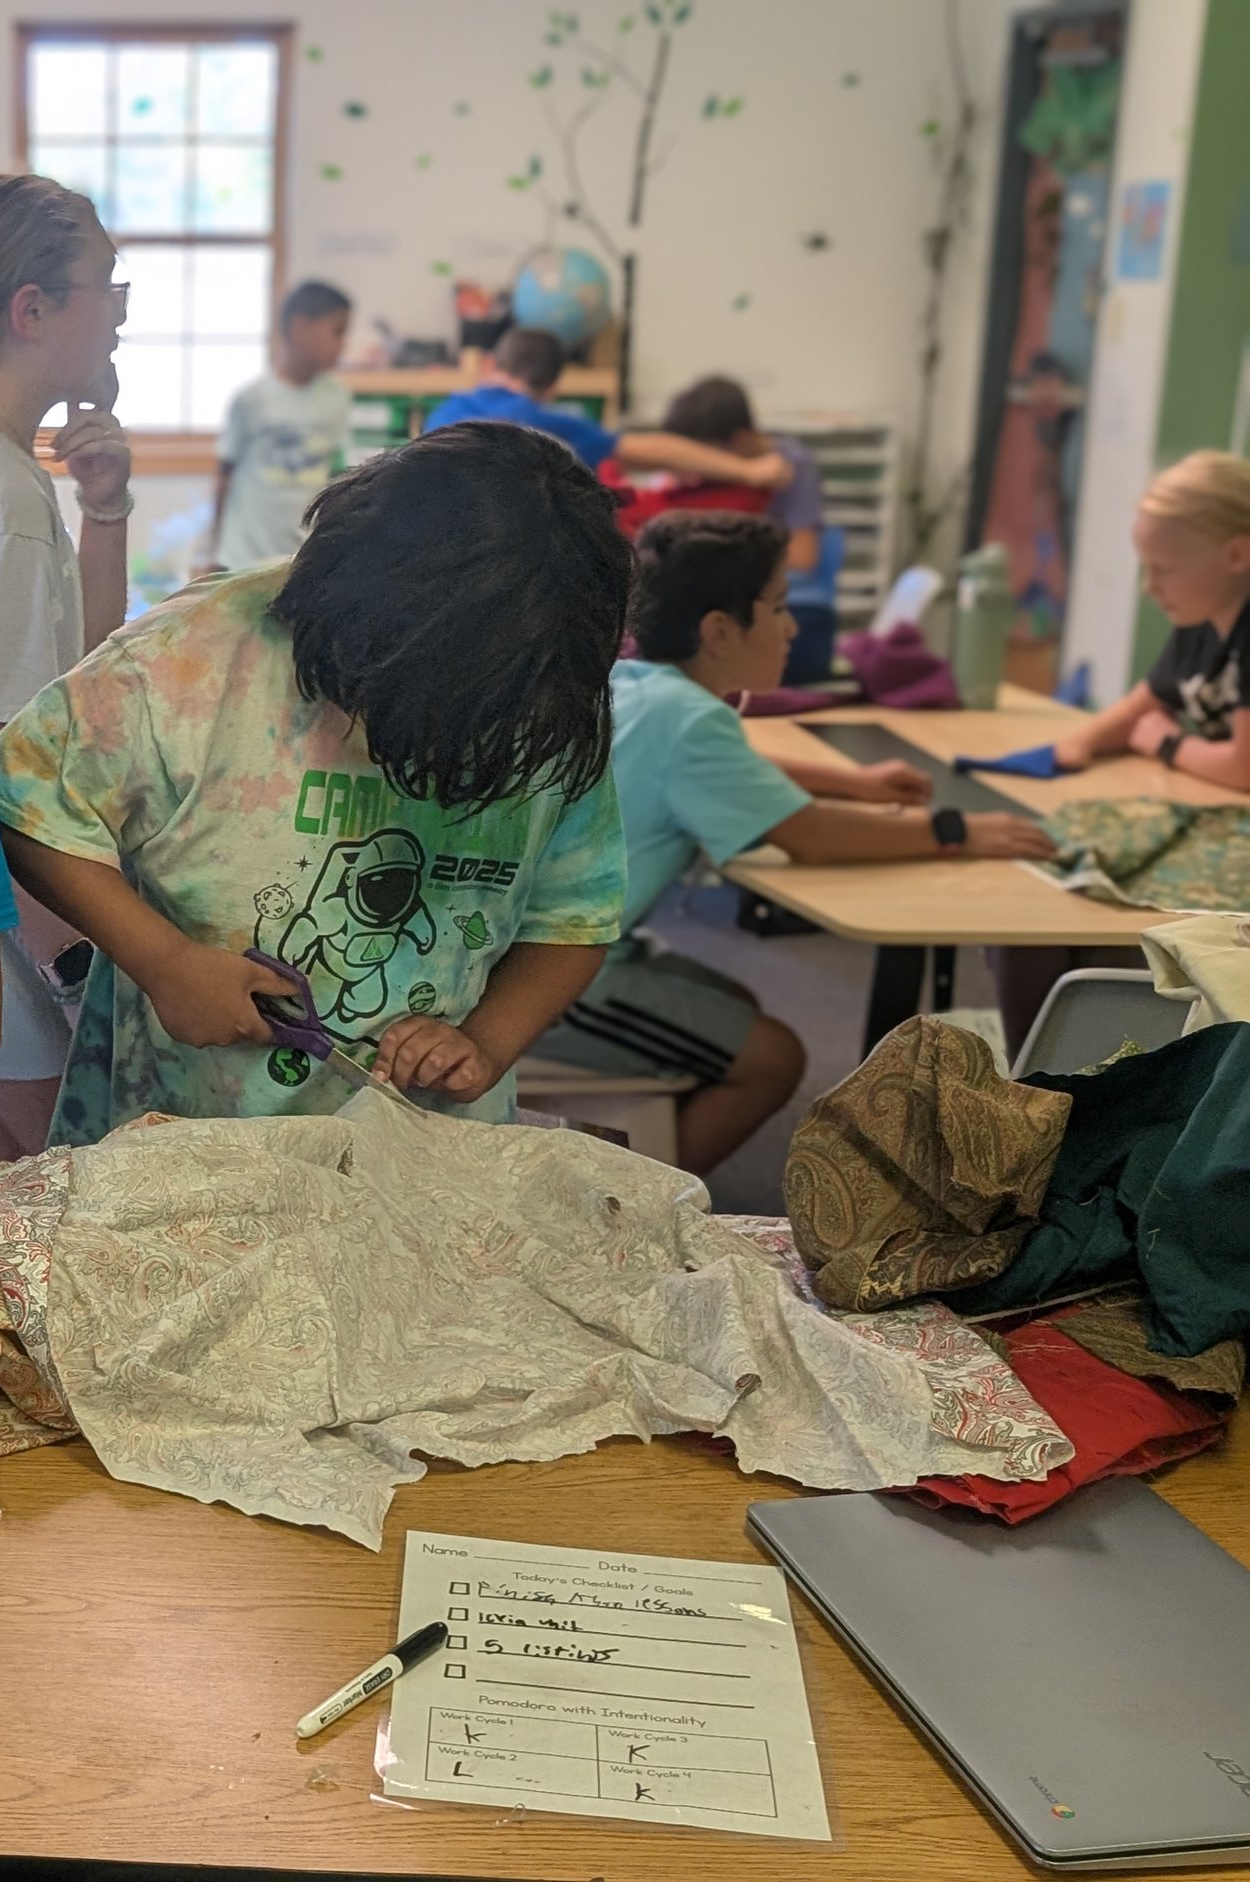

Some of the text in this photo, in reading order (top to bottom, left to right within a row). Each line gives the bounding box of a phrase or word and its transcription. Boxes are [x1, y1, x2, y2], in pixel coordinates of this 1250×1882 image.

[430, 854, 520, 886] 2025
[422, 1543, 468, 1557] Name
[598, 1560, 638, 1574] Date
[512, 1571, 567, 1585] Today's
[572, 1577, 635, 1591] Checklist
[654, 1585, 694, 1597] Goals
[380, 1668, 392, 1681] DRY
[365, 1676, 381, 1692] ERASE
[343, 1688, 363, 1707] Marker
[440, 1711, 471, 1721] Work
[475, 1715, 507, 1725] Cycle
[478, 1694, 707, 1729] Pomodoro with Intentionality
[608, 1729, 641, 1739] Work
[644, 1733, 677, 1743] Cycle
[438, 1745, 518, 1762] Work Cycle 2
[609, 1764, 644, 1776] Work
[646, 1769, 680, 1779] Cycle
